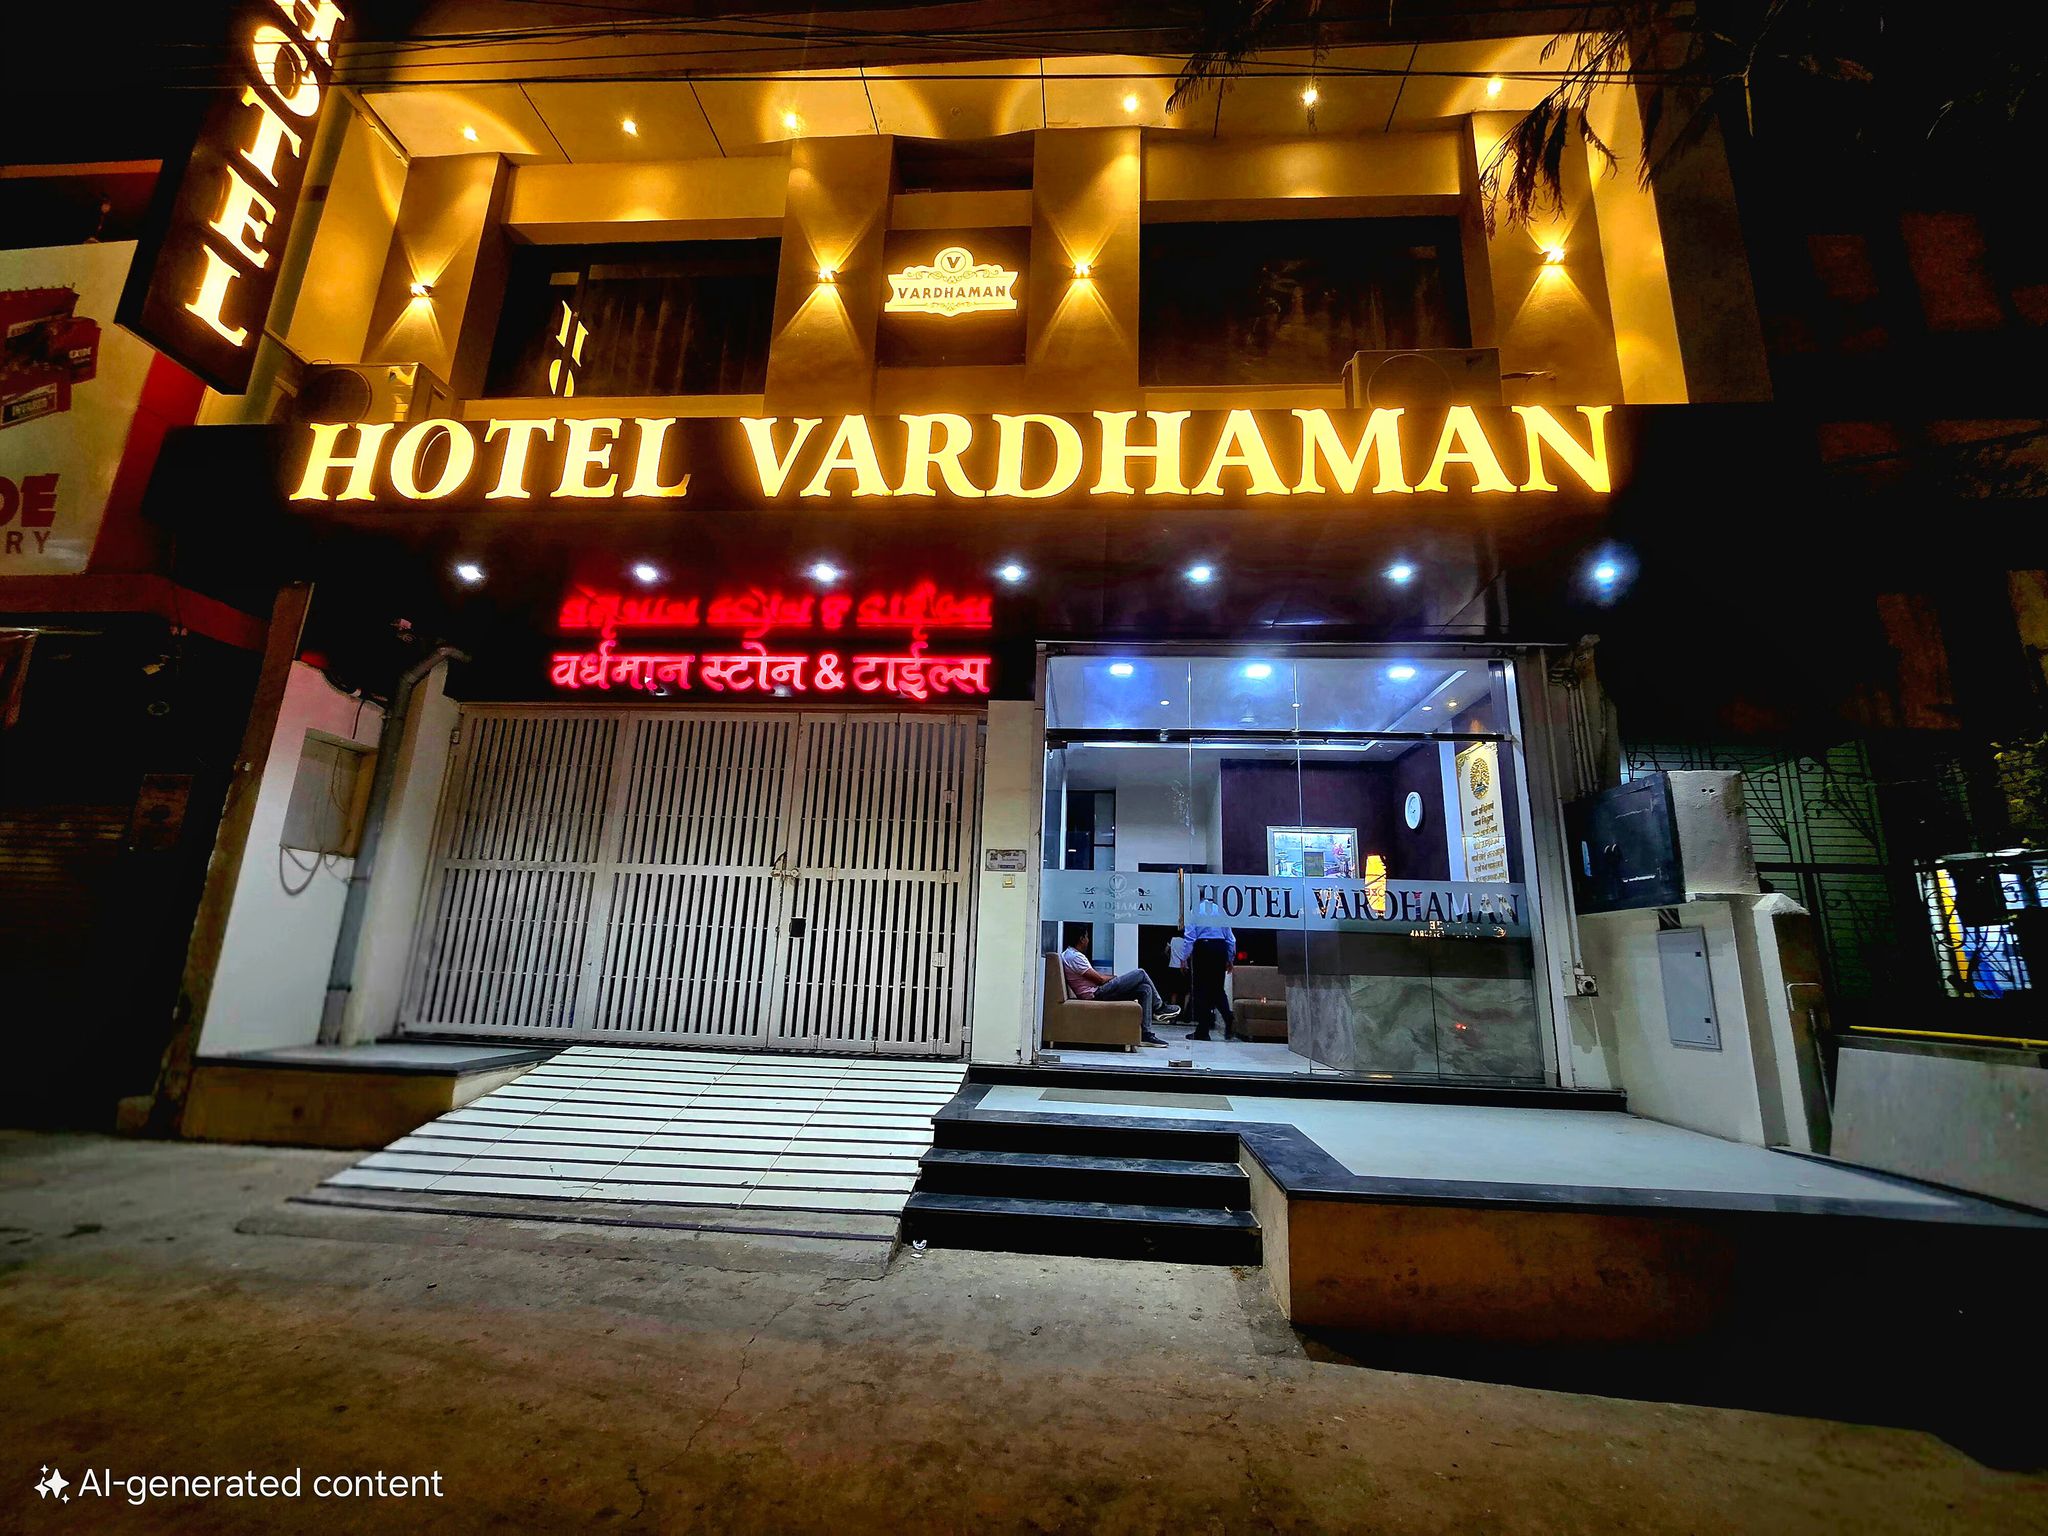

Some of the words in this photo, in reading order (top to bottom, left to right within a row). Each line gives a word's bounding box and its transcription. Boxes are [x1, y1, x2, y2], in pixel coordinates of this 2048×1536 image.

[946, 256, 961, 269] V
[898, 285, 1006, 299] VARDHAMAN
[289, 417, 692, 501] HOTEL
[739, 405, 1613, 498] VARDHAMAN
[552, 640, 695, 690] वर्धमान
[701, 641, 809, 691] स्टोन
[814, 653, 846, 690] &
[852, 641, 992, 699] टाईल्स
[1197, 885, 1300, 919] HOTEL
[1312, 887, 1519, 925] VARDHAMAN
